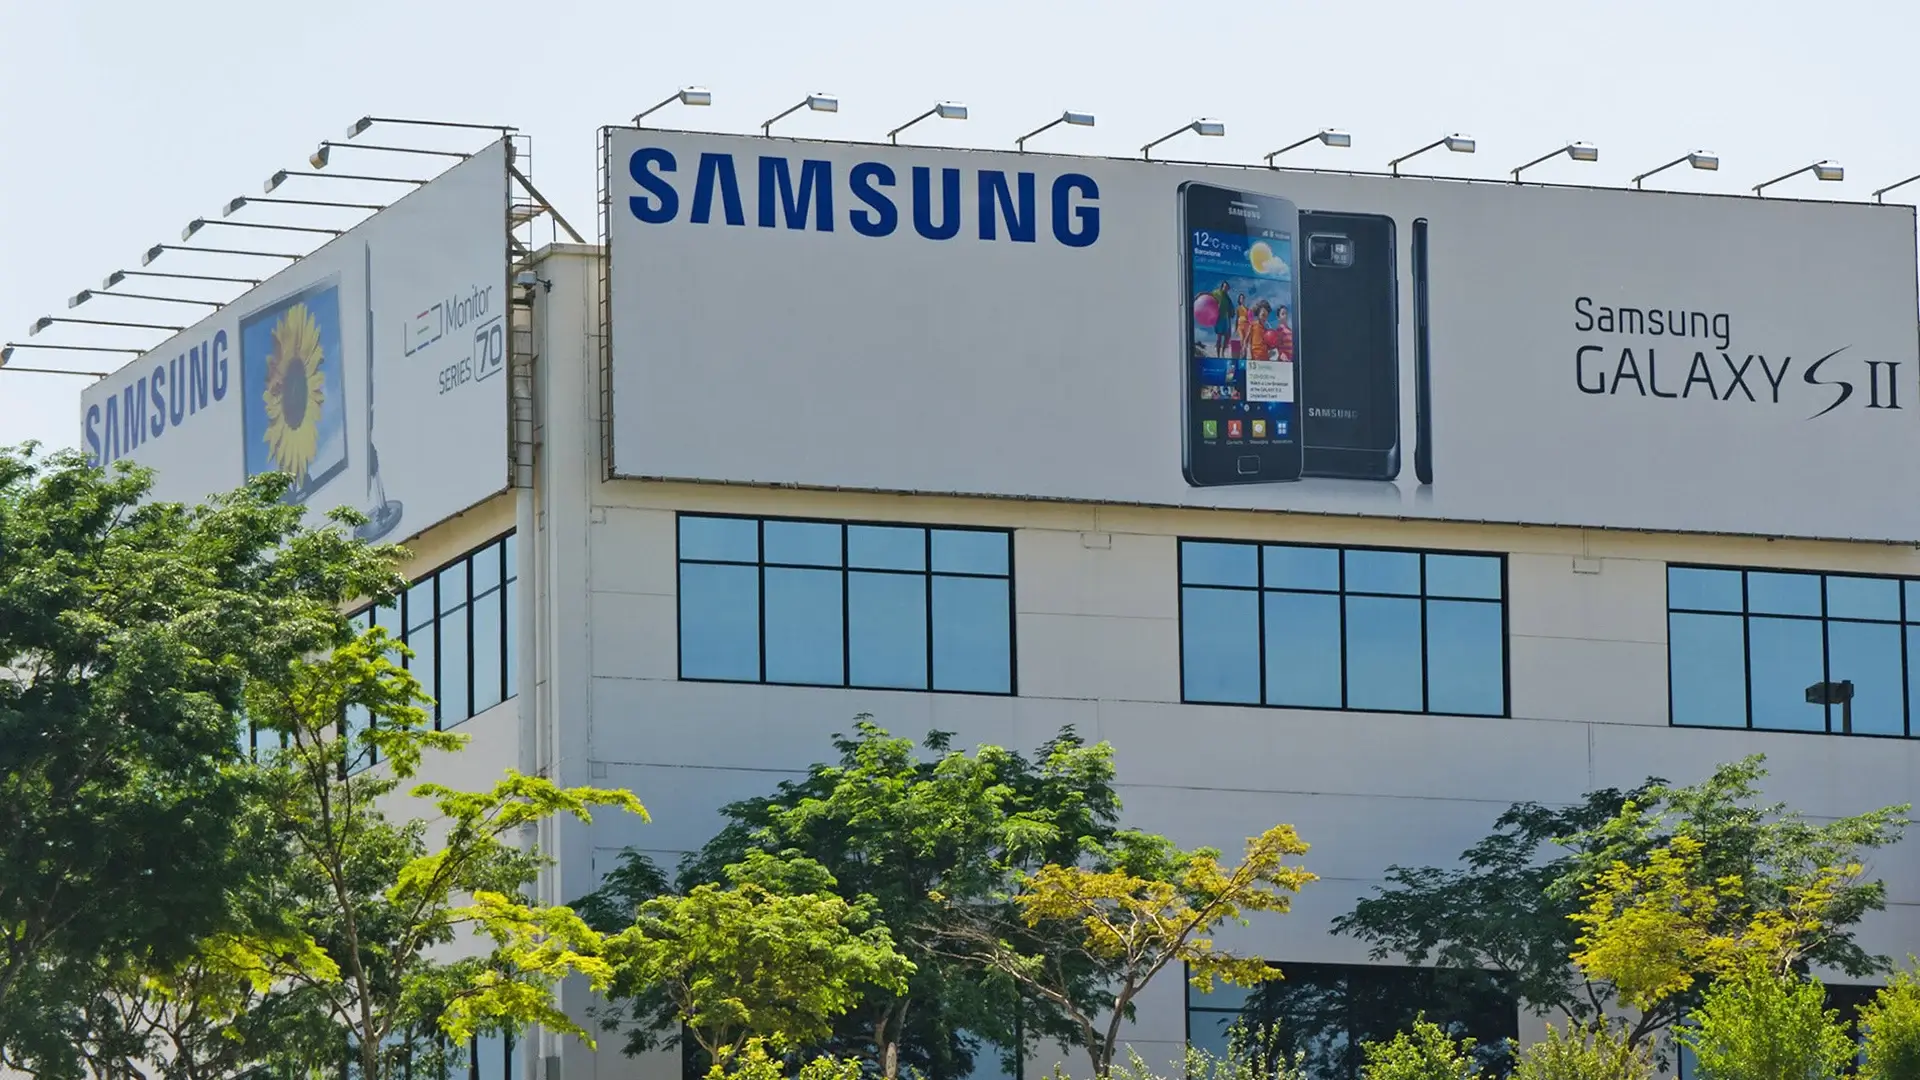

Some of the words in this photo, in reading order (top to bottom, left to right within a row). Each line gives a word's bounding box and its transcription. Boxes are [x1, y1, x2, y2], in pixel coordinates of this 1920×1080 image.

[629, 147, 1101, 248] SAMSUNG
[404, 302, 442, 357] LED
[446, 284, 493, 335] Monitor
[1575, 296, 1730, 350] Samsung
[439, 357, 472, 395] SERIES
[476, 324, 503, 373] 70
[1576, 345, 1791, 403] GALAXY
[1803, 344, 1853, 421] S
[1864, 360, 1903, 410] II
[85, 329, 229, 469] SAMSUNG
[1308, 407, 1359, 419] SAMSUNG
